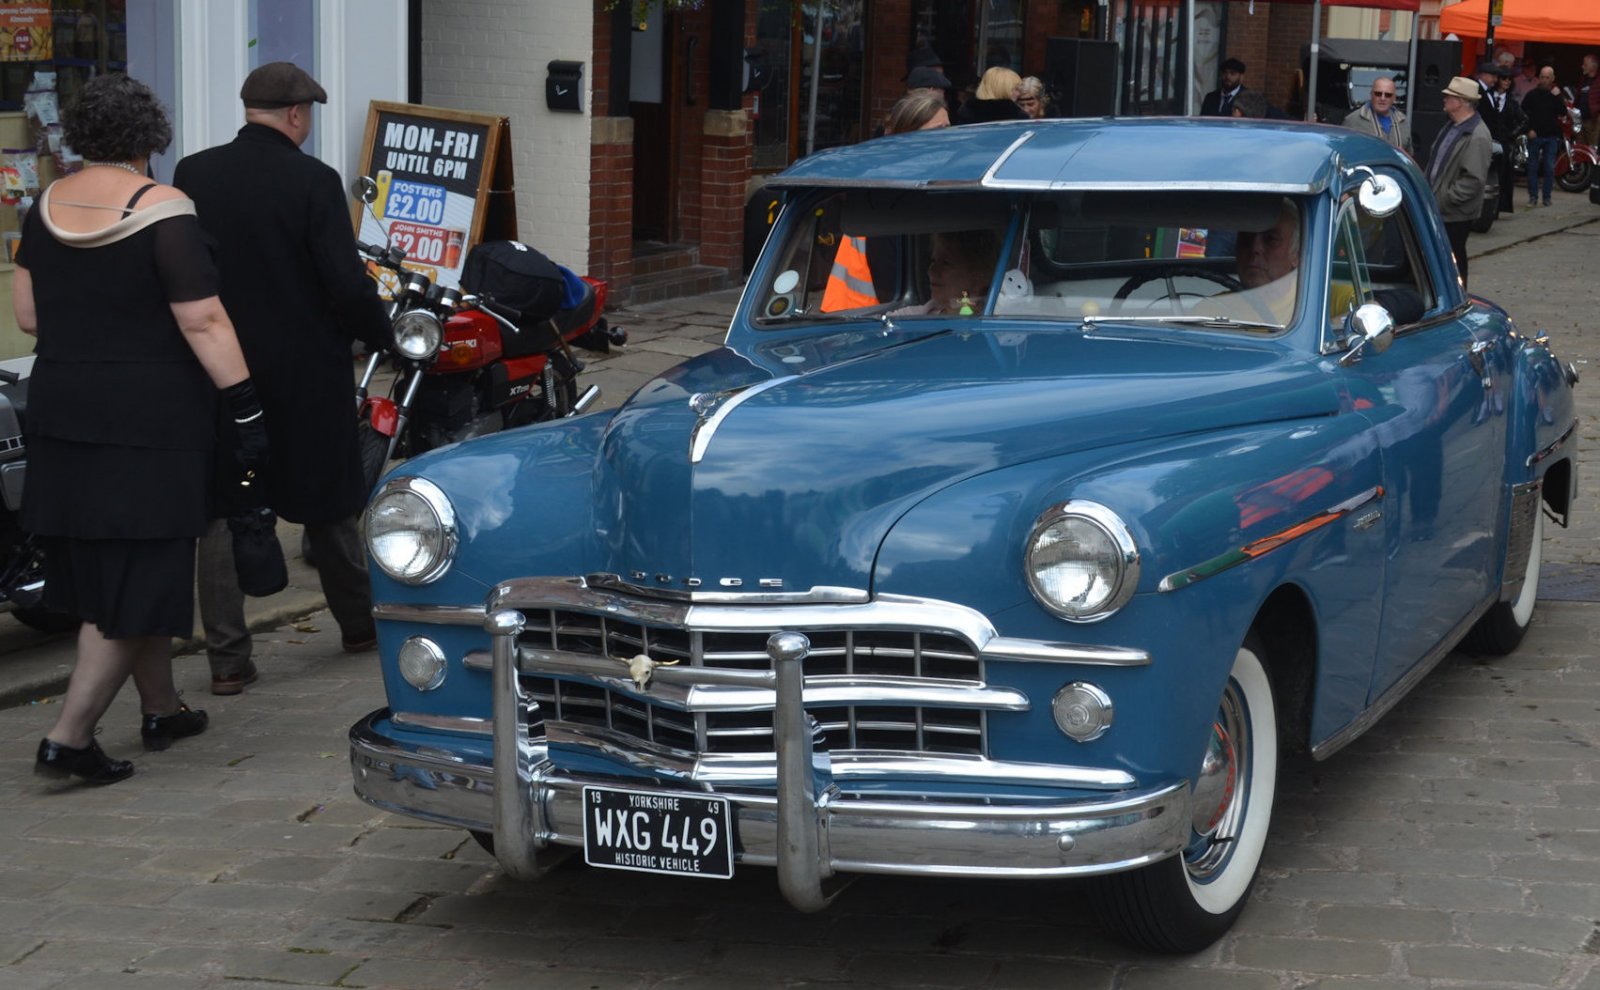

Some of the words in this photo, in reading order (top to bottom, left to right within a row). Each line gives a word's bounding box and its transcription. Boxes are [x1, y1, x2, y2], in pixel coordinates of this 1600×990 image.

[384, 122, 479, 159] MON-FRI
[386, 151, 429, 175] UNTIL
[433, 160, 468, 180] 6PM
[393, 182, 442, 198] FOSTERS
[387, 193, 443, 223] £2.00
[394, 223, 415, 233] JOHN
[416, 227, 443, 237] SMITHS
[591, 791, 602, 804] 19
[629, 795, 680, 811] YORKSHIRE
[707, 801, 719, 815] 49
[594, 807, 651, 851] WXG
[661, 813, 718, 856] 449
[615, 852, 657, 868] HISTORIC
[660, 856, 700, 872] VEHICLE
